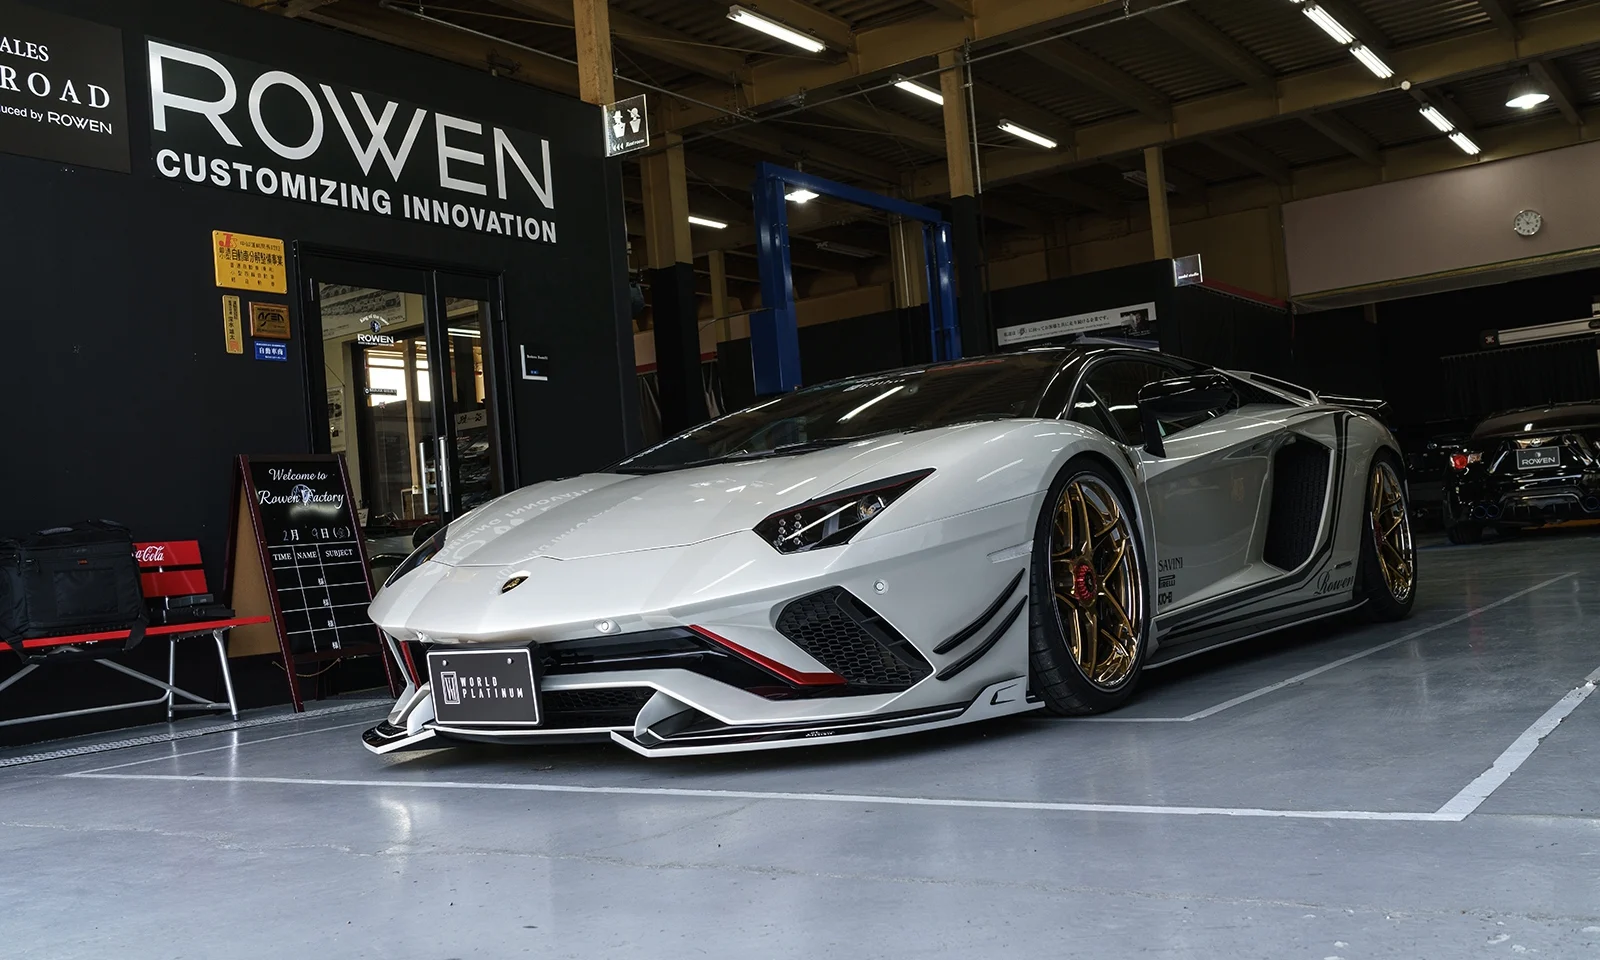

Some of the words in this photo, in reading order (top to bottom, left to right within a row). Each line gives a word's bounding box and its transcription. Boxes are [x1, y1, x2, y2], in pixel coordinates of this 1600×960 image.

[0, 105, 27, 118] uced
[30, 109, 43, 123] by
[48, 112, 112, 134] ROWEN
[148, 40, 554, 210] ROWEN
[156, 149, 393, 215] CUSTOMIZING
[403, 194, 557, 244] INNOVATION
[357, 333, 394, 343] ROWEN
[1521, 456, 1556, 465] ROWEN
[268, 468, 316, 481] Welcome
[317, 470, 328, 480] to
[258, 490, 301, 505] Rowen
[272, 552, 292, 561] TIME
[296, 550, 318, 560] NAME
[325, 548, 353, 558] SUBJECT
[1158, 557, 1183, 572] SAVINI
[1313, 569, 1354, 596] Rowen
[460, 676, 498, 687] WORLD
[462, 687, 524, 698] PLATINUM
